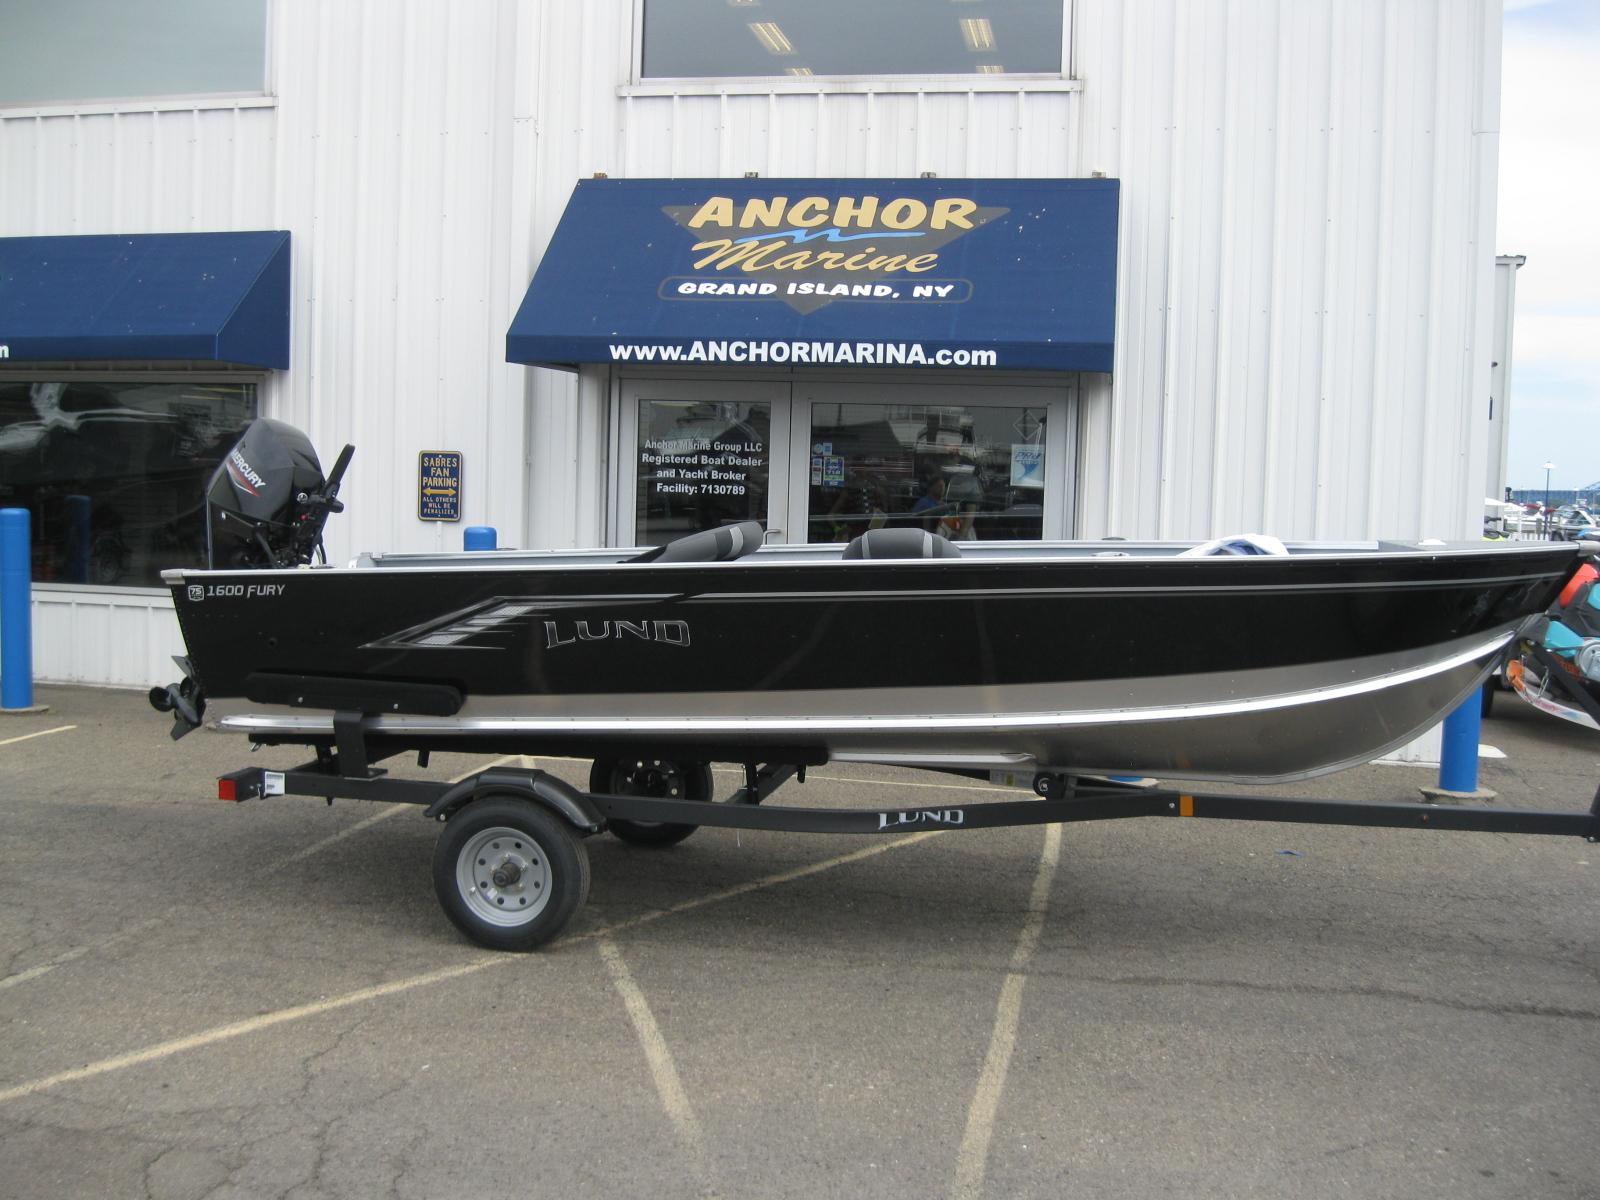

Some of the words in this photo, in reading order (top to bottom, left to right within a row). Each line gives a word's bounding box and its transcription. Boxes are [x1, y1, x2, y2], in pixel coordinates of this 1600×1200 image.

[688, 196, 978, 230] ANCHOR
[691, 239, 939, 272] Marine
[677, 282, 778, 296] GRAND
[787, 282, 900, 299] ISLAND,
[912, 284, 955, 298] NY
[609, 340, 997, 366] www.ANCHORMARINA.com
[644, 439, 677, 450] Anchor
[679, 439, 711, 450] Marine
[714, 441, 741, 453] Group
[744, 442, 762, 452] LLC
[423, 457, 457, 467] SABRES
[642, 453, 698, 466] Registered
[701, 455, 725, 465] Boat
[728, 456, 763, 466] Dealer
[230, 448, 266, 488] MERCURY
[431, 467, 449, 477] FAN
[656, 469, 675, 478] and
[679, 469, 708, 479] Yacht
[711, 470, 746, 481] Broker
[422, 477, 457, 487] PARKING
[656, 482, 698, 495] Facility:
[701, 484, 745, 495] 7130789
[206, 585, 244, 596] 1600
[247, 584, 286, 599] FURY
[544, 620, 691, 649] LUND
[878, 809, 964, 830] LUND
